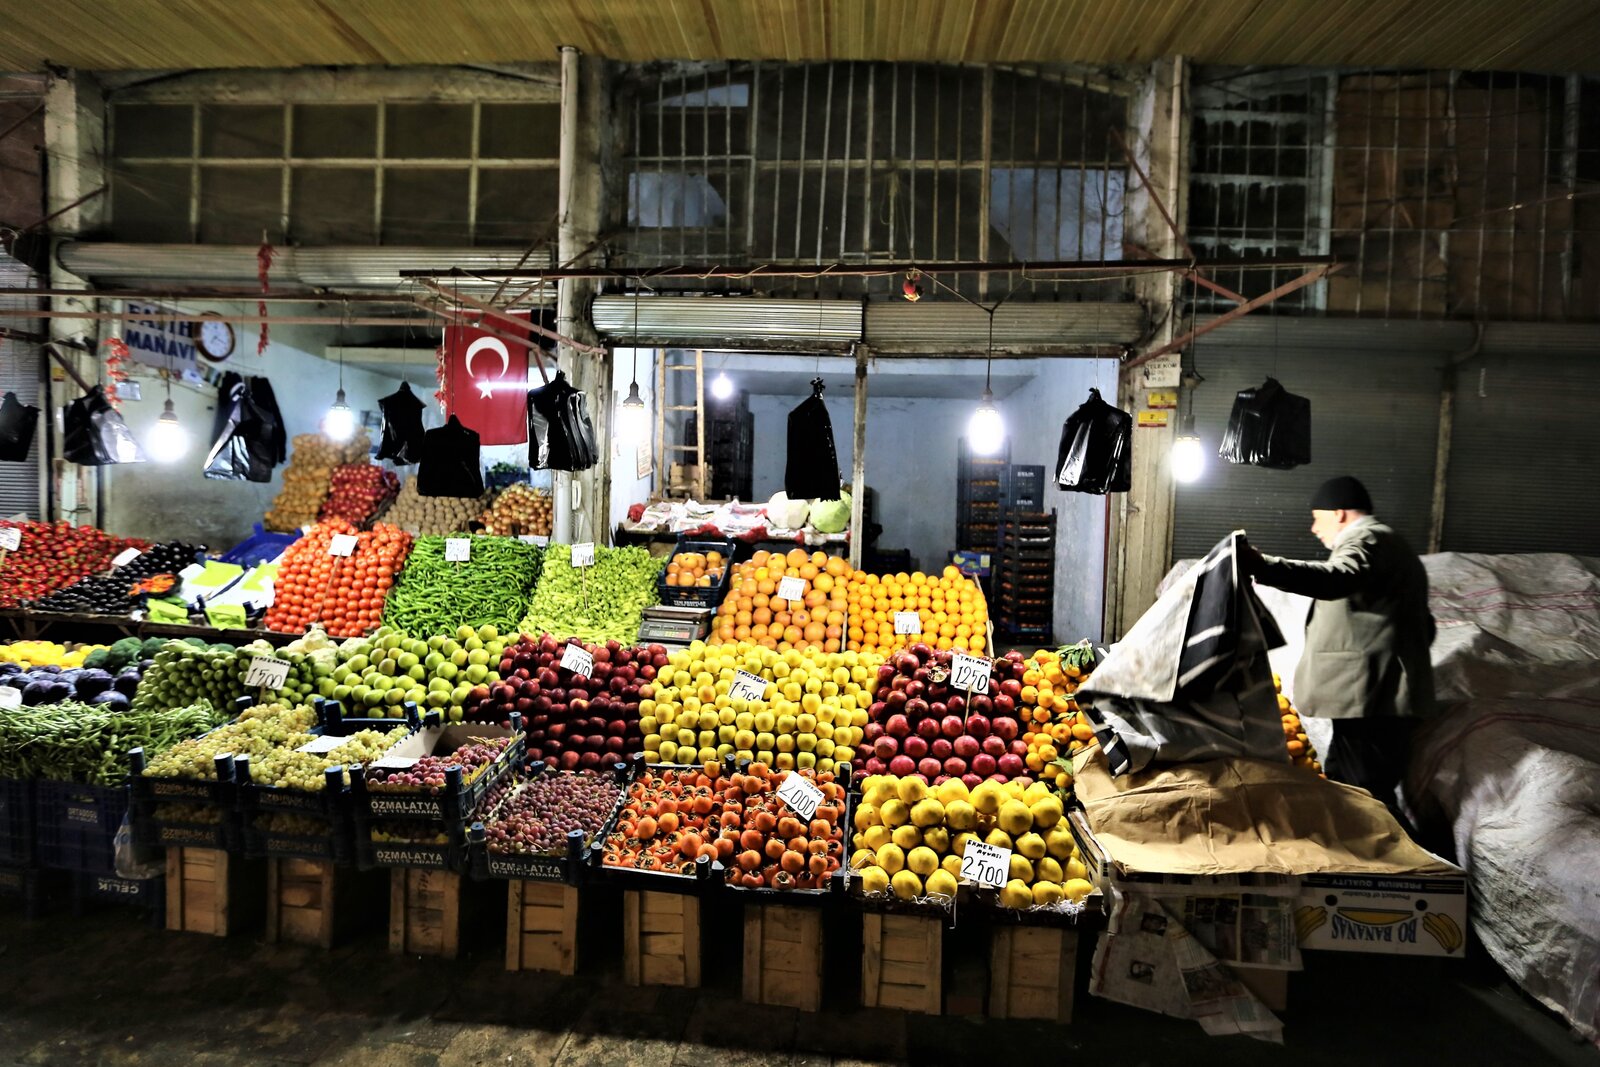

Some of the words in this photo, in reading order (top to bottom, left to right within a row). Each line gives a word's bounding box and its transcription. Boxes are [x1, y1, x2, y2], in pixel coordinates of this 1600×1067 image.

[955, 665, 988, 691] 1250
[1332, 879, 1373, 887] QUALITY
[1377, 881, 1422, 889] PREMIUM
[1331, 914, 1393, 942] BANANAS
[1398, 917, 1419, 944] BO
